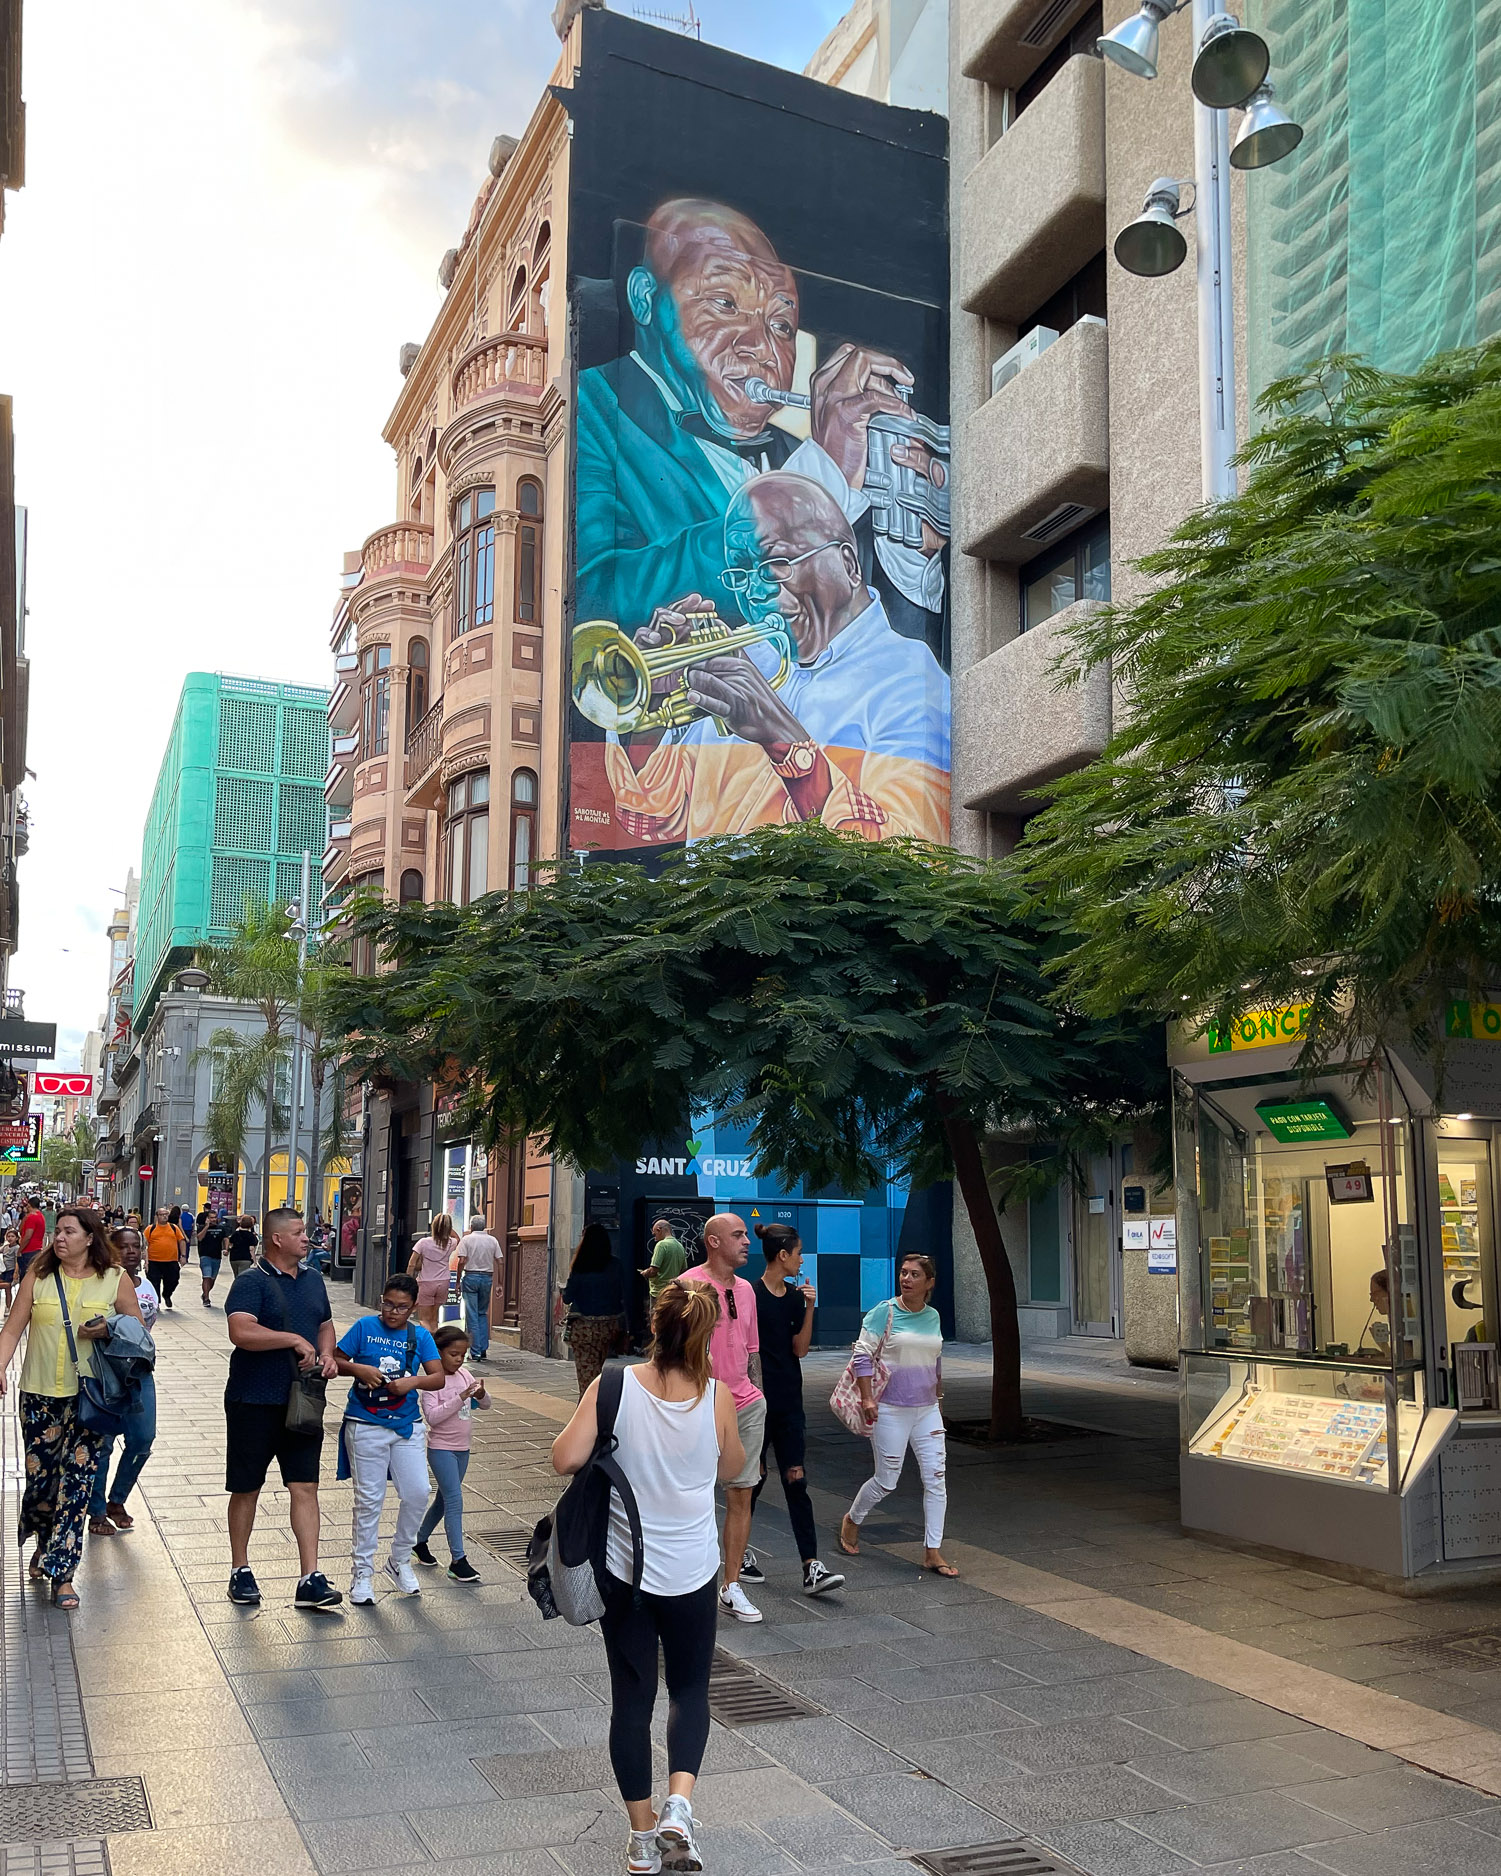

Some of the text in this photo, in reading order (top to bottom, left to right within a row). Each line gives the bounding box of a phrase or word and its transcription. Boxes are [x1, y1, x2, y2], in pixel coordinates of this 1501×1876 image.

[574, 808, 601, 817] SABOTAJE
[584, 816, 610, 825] MONTAJE
[1269, 1112, 1328, 1125] PAGO CON TARJETA
[1286, 1123, 1325, 1134] DISPONIBLE
[702, 1159, 751, 1177] CRUZ
[1345, 1180, 1361, 1190] 49
[366, 1335, 392, 1346] THINK
